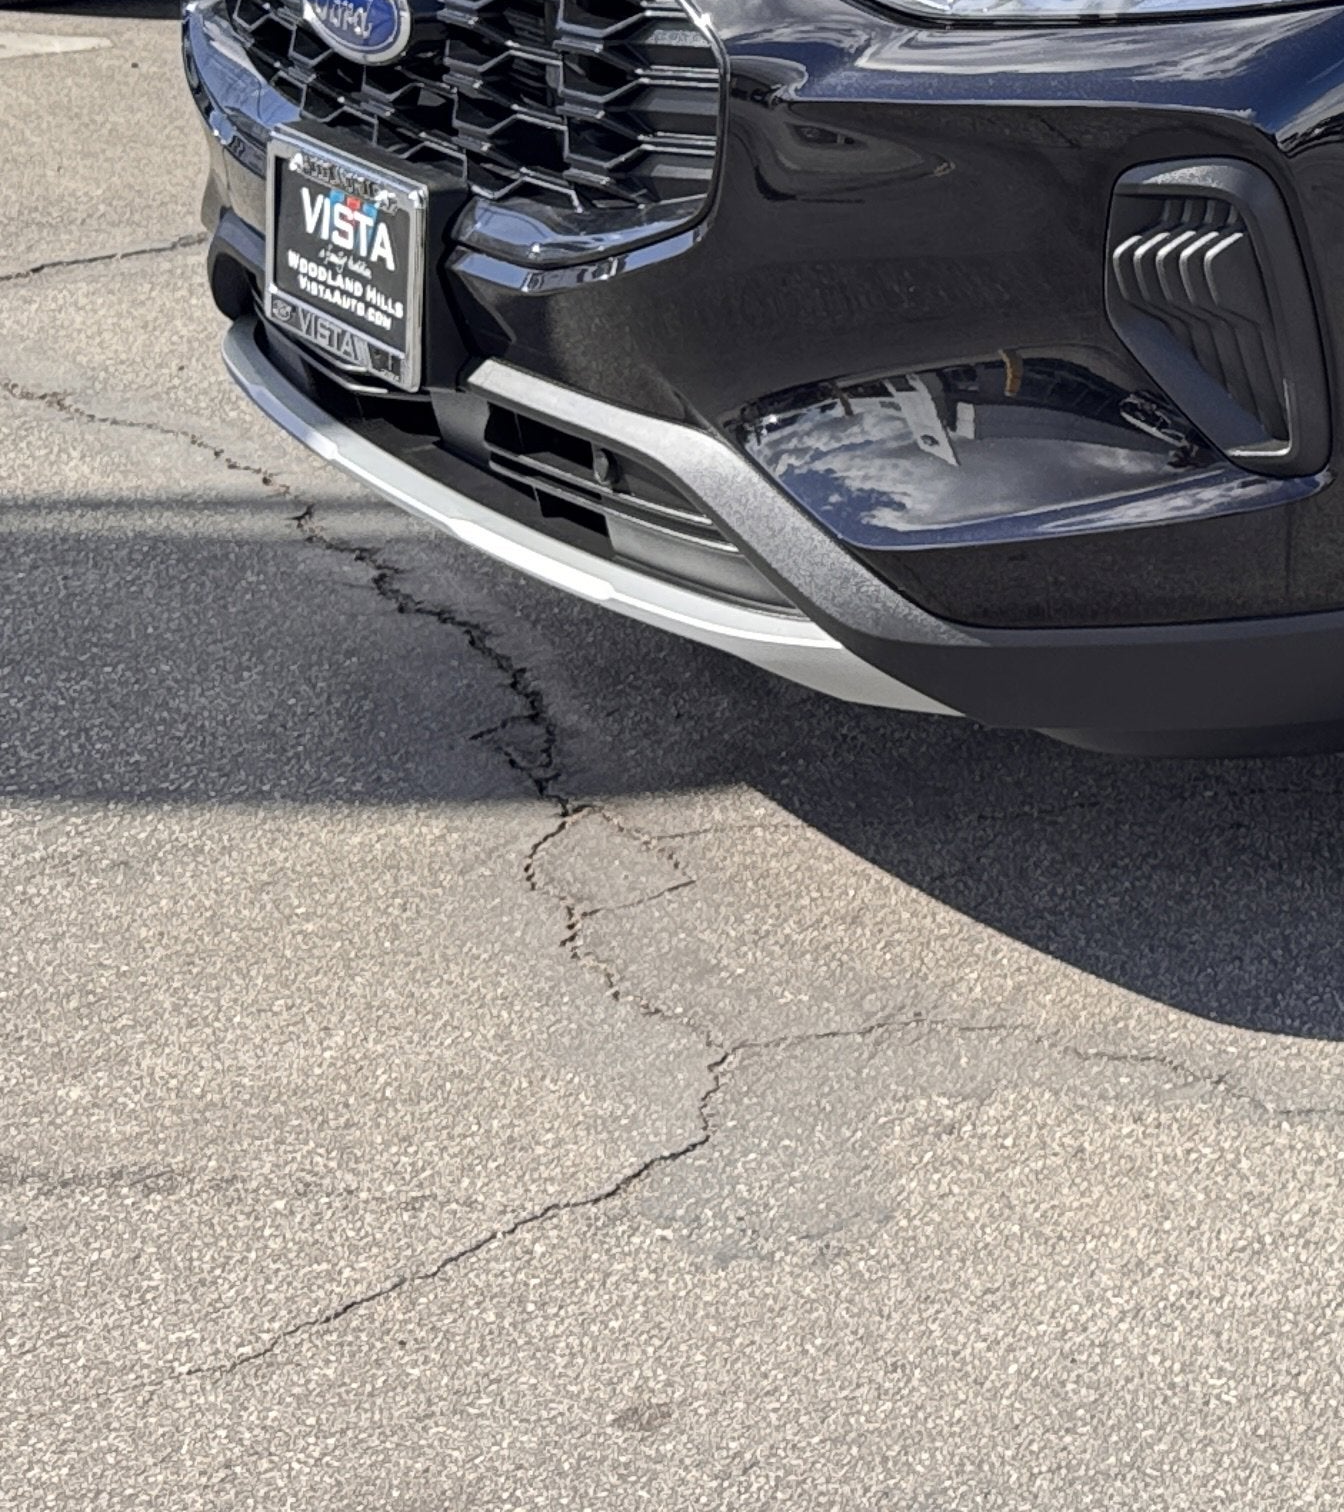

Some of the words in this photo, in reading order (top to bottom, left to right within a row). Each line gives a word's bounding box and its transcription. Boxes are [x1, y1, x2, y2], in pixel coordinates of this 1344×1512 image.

[300, 187, 395, 272] VISTA
[287, 249, 364, 298] WOODLAND
[365, 282, 404, 320] HILLS
[296, 306, 360, 361] VISTA
